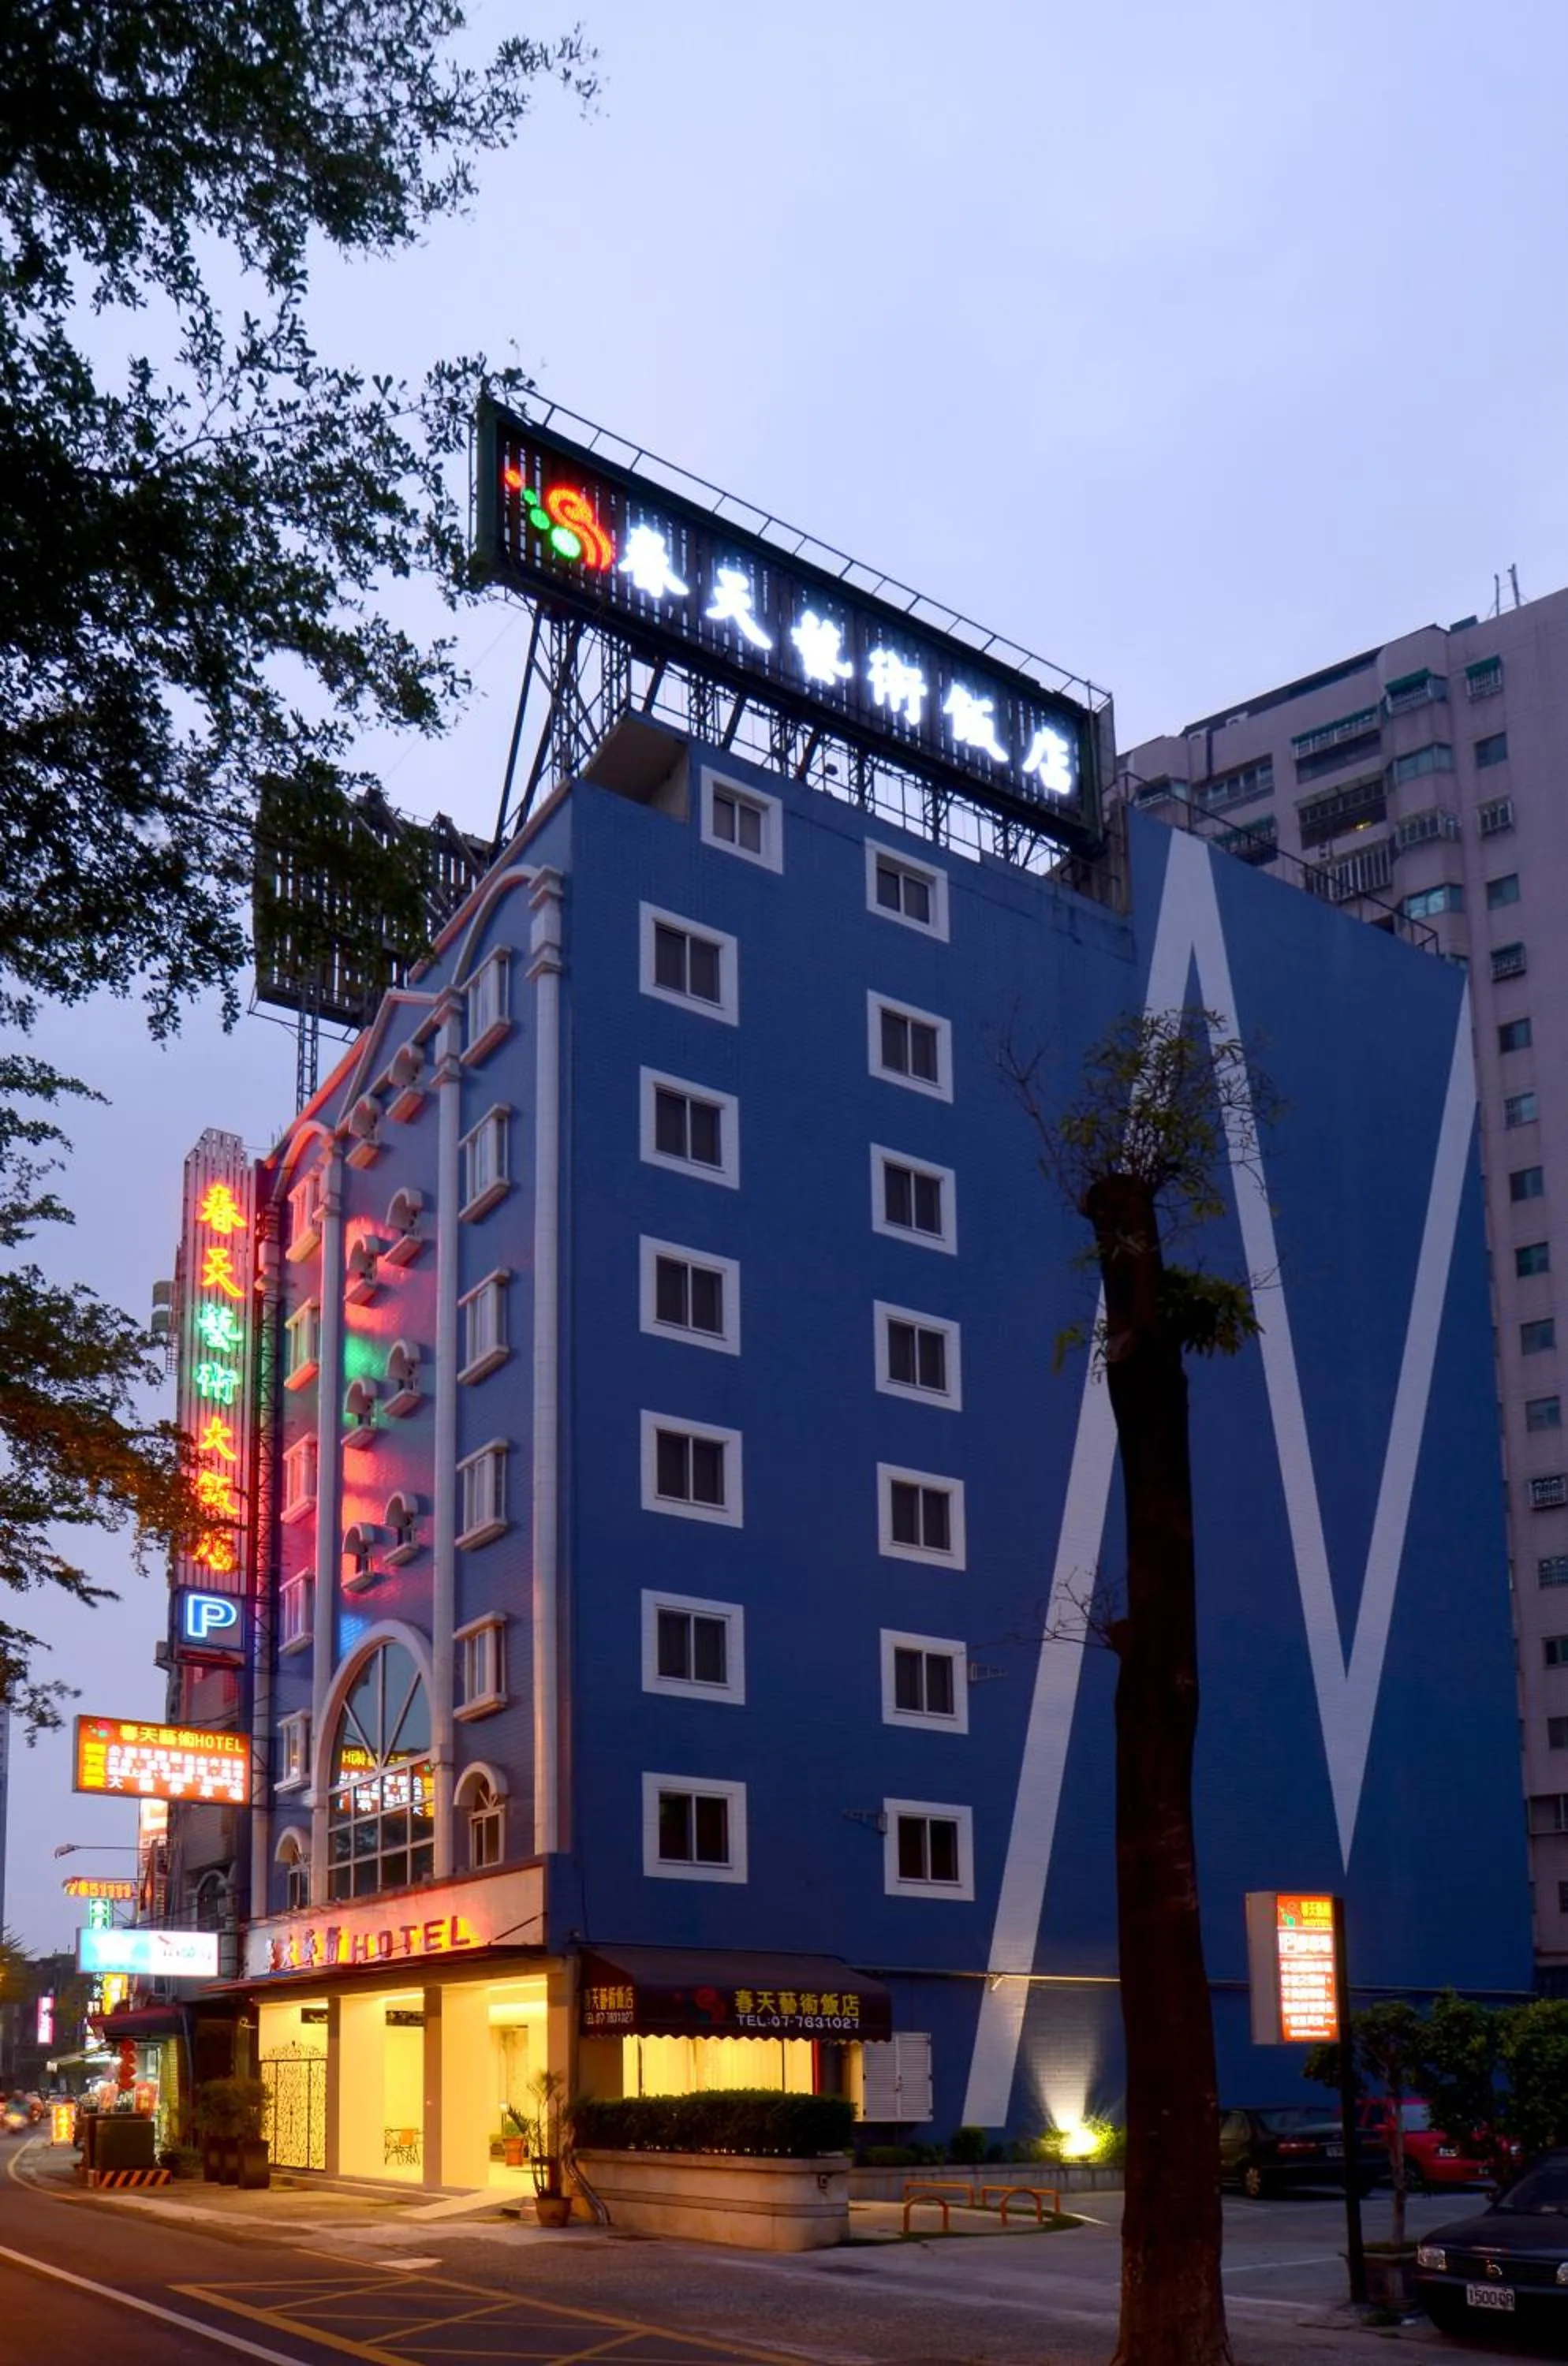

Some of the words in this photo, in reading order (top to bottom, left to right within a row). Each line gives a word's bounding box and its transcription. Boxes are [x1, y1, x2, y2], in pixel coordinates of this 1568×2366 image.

[618, 524, 1073, 797] 春天藝術飯店
[186, 1593, 237, 1639] P
[352, 1915, 472, 1964] HOTEL
[734, 1987, 861, 2017] 春天藝術飯店
